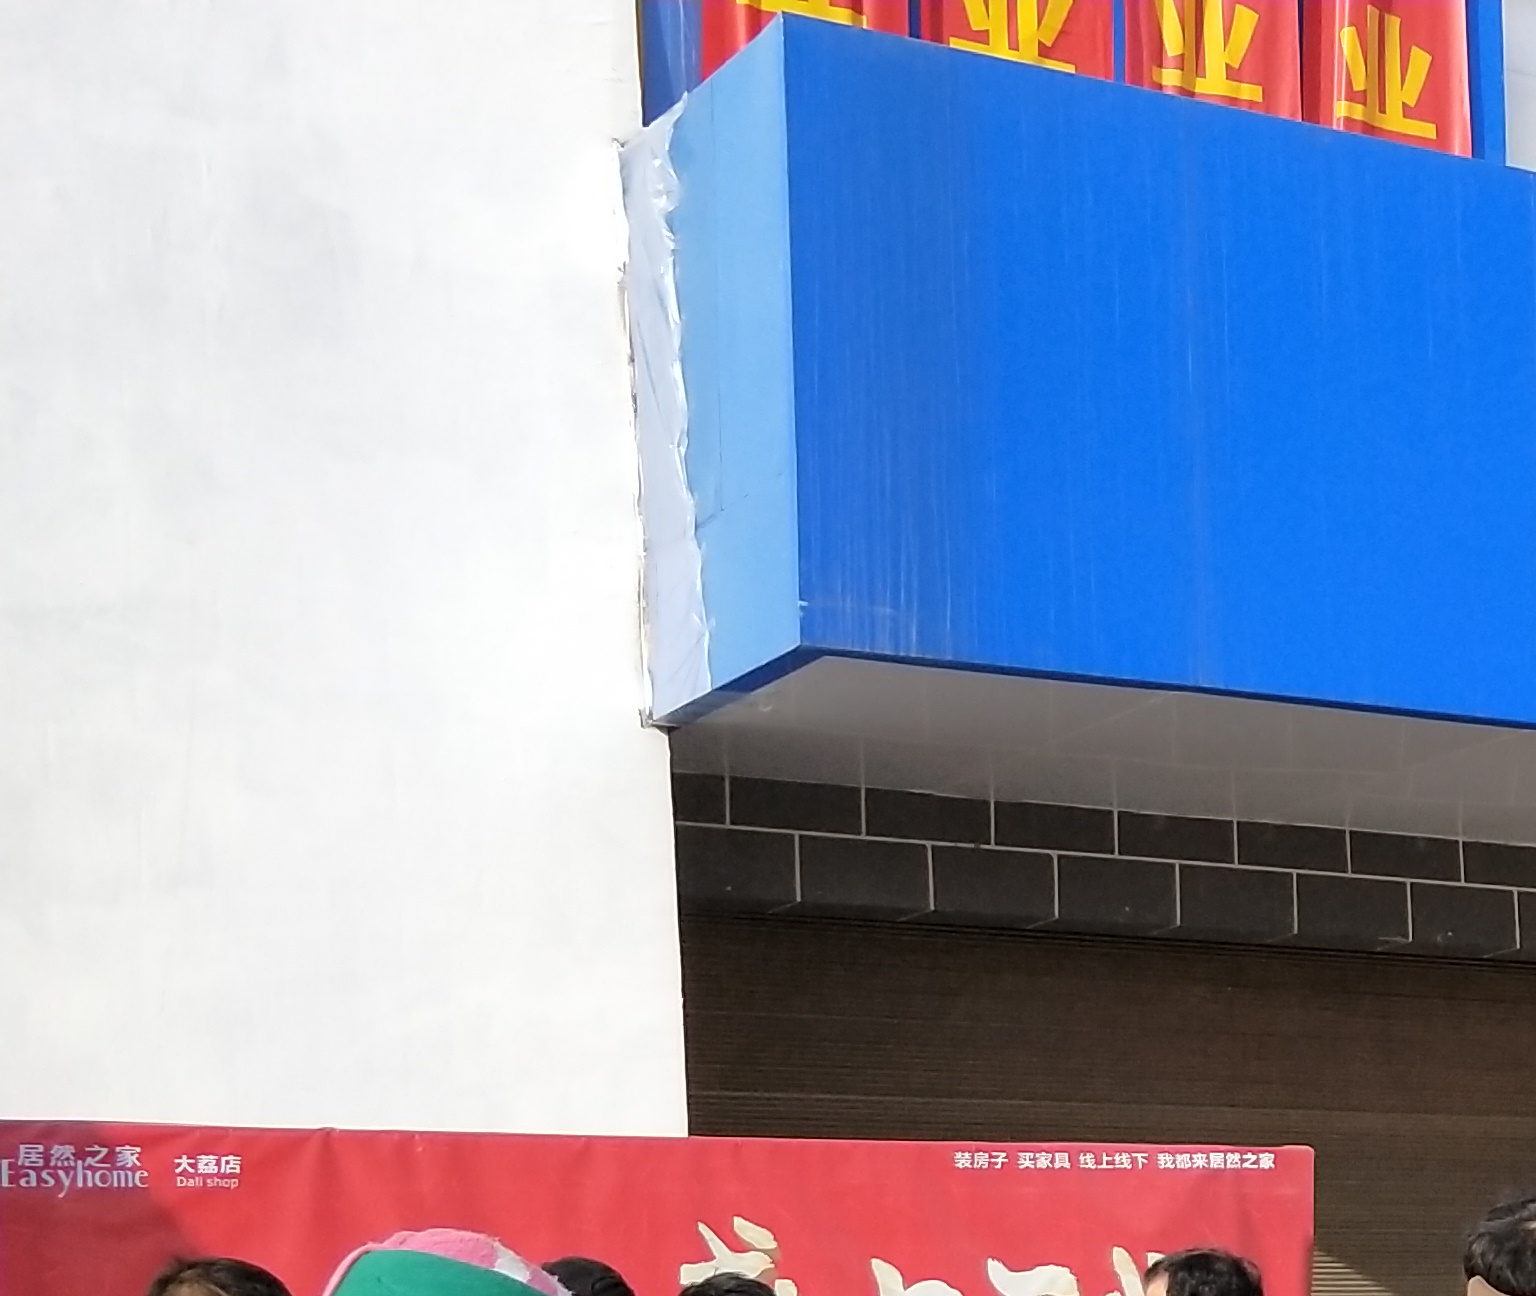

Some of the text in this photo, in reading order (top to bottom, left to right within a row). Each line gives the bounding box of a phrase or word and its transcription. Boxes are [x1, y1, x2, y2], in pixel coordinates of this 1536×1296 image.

[1152, 0, 1263, 102] 业
[1337, 4, 1438, 139] 业
[18, 1144, 143, 1168] 居然之家
[173, 1154, 243, 1175] 大荔店
[953, 1151, 1276, 1171] 装房子 买家具 线上线下 我都来居然之家
[1, 1159, 149, 1198] Easyhome
[206, 1175, 240, 1191] shop
